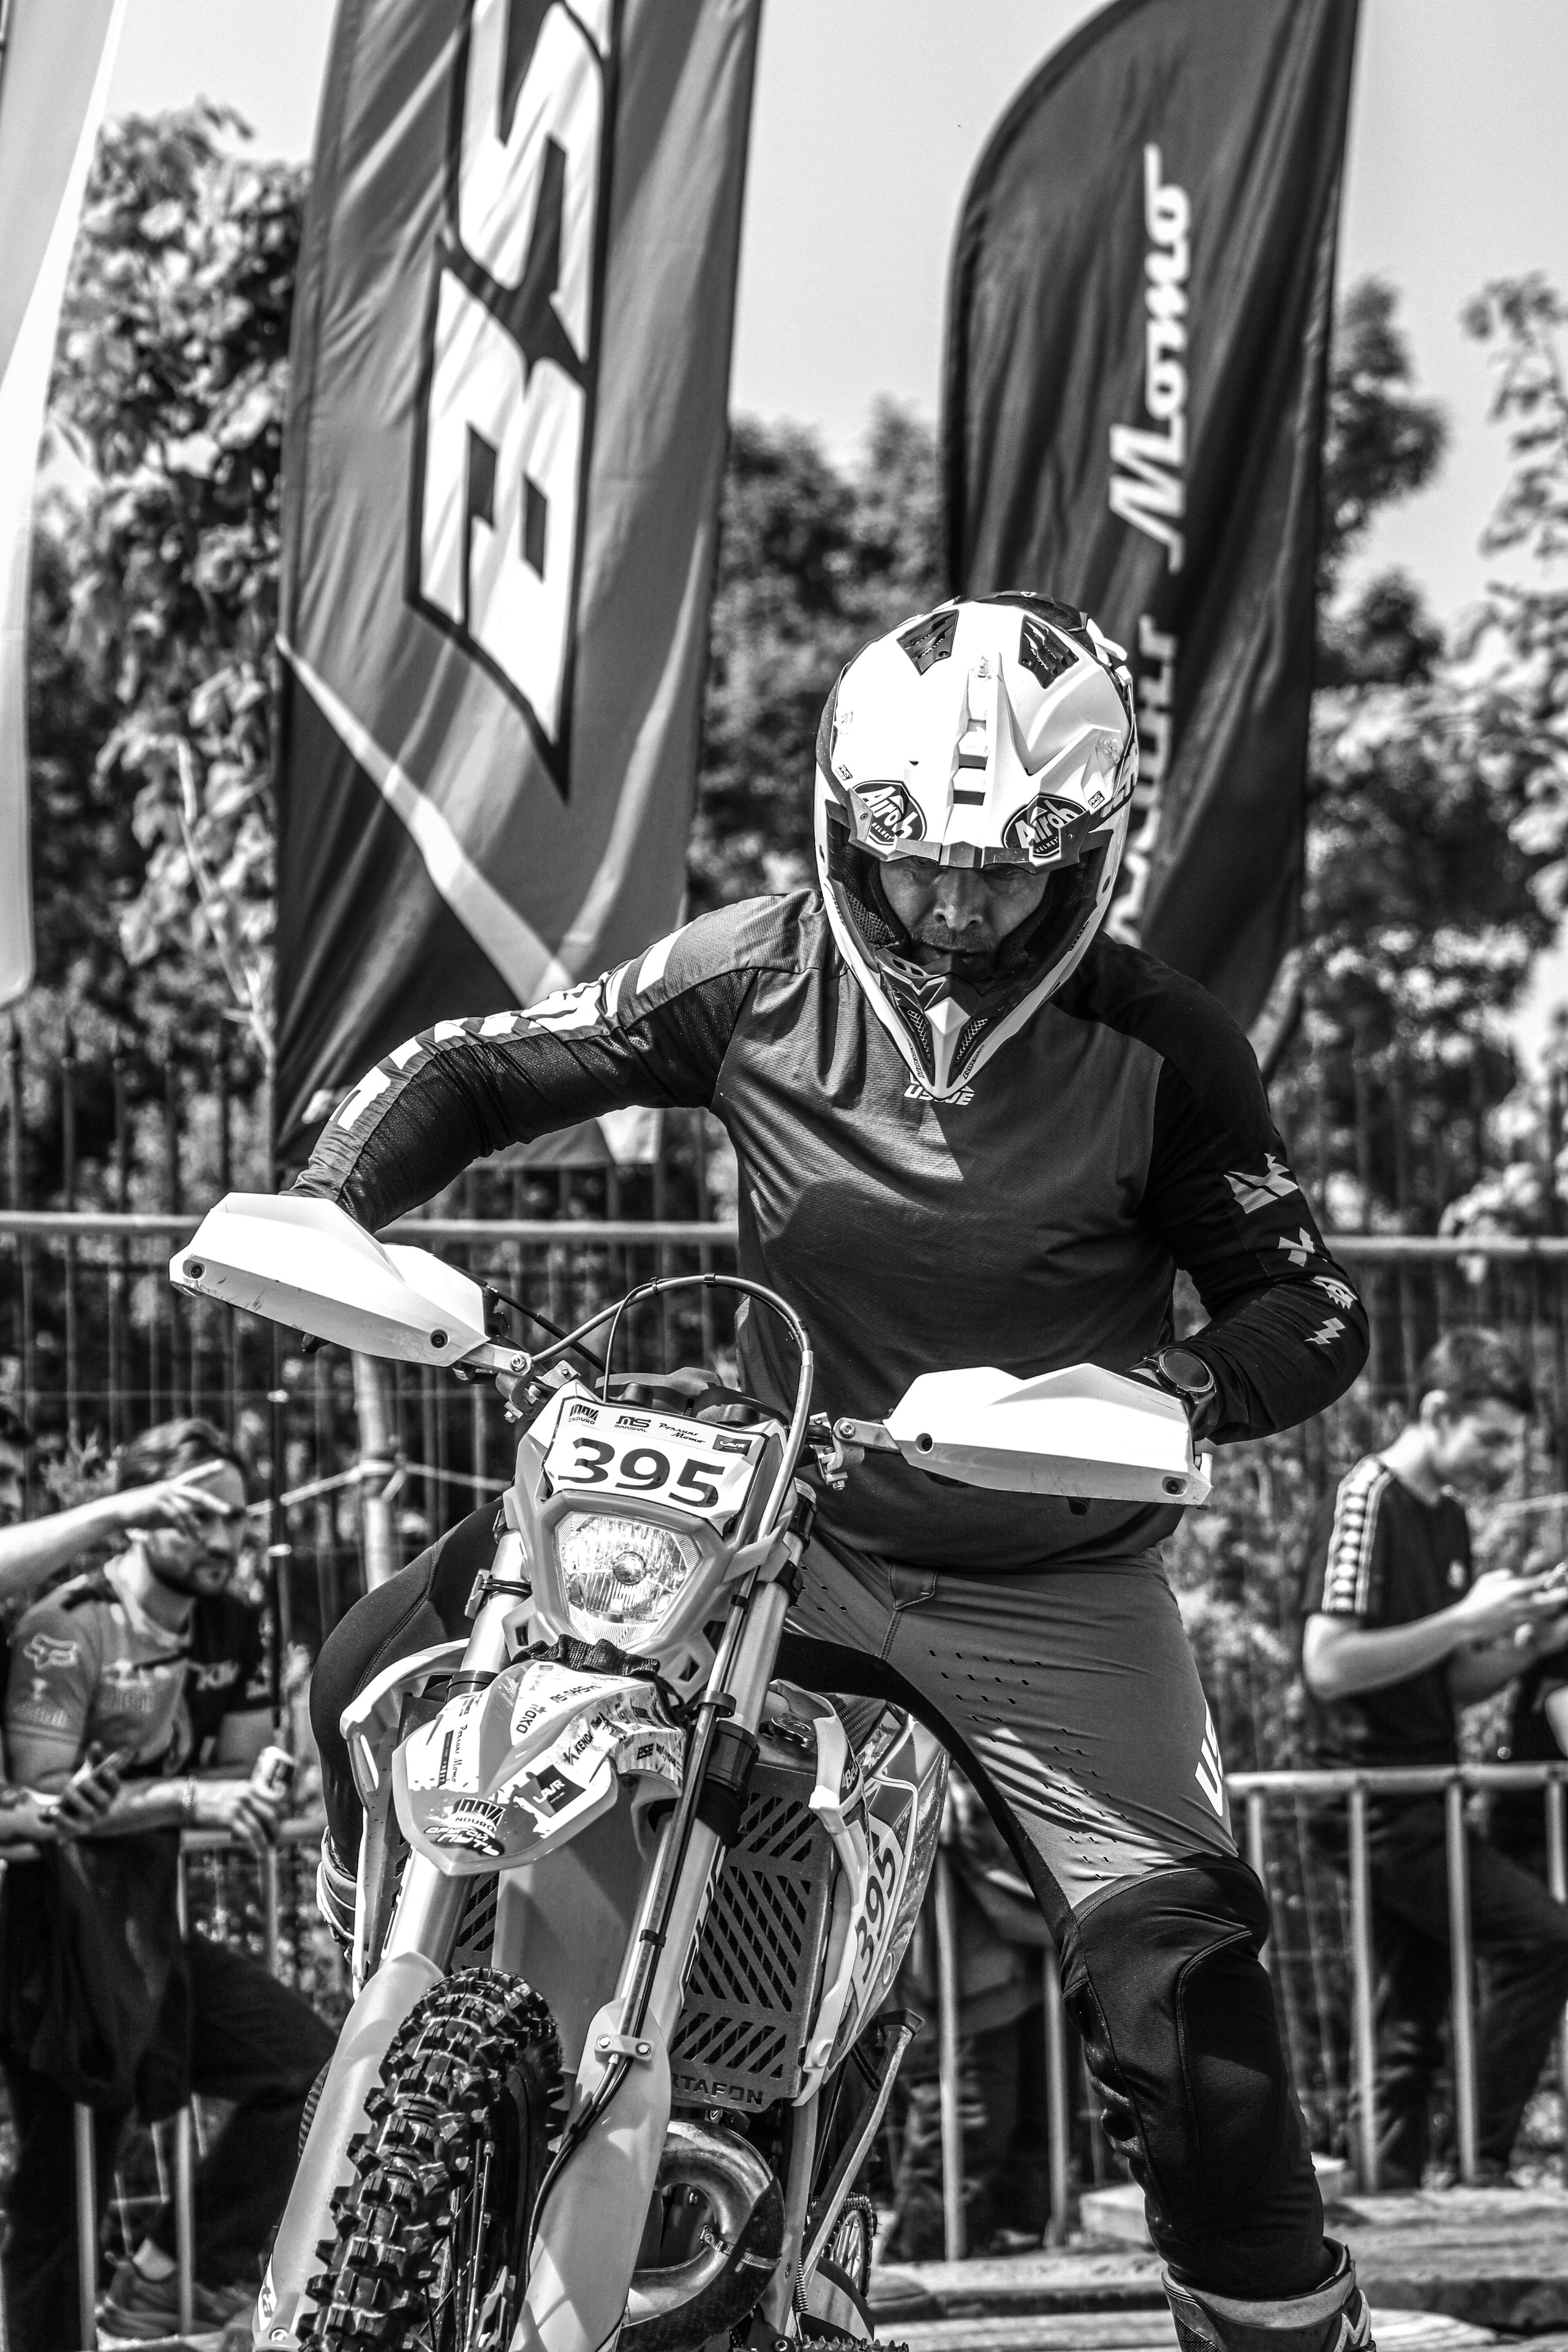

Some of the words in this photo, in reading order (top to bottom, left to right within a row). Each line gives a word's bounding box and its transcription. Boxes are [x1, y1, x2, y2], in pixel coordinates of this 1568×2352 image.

[418, 0, 614, 745] BS
[858, 786, 919, 839] Airoh
[1015, 799, 1079, 849] Airoh
[871, 822, 894, 841] HELMET
[1035, 836, 1058, 853] HELMET
[568, 1415, 595, 1425] ENDURO
[614, 1424, 647, 1433] MARSHAL
[558, 1437, 726, 1508] 395
[573, 1731, 595, 1756] KENDA
[532, 1778, 566, 1804] LAVR
[859, 1834, 897, 1985] 395
